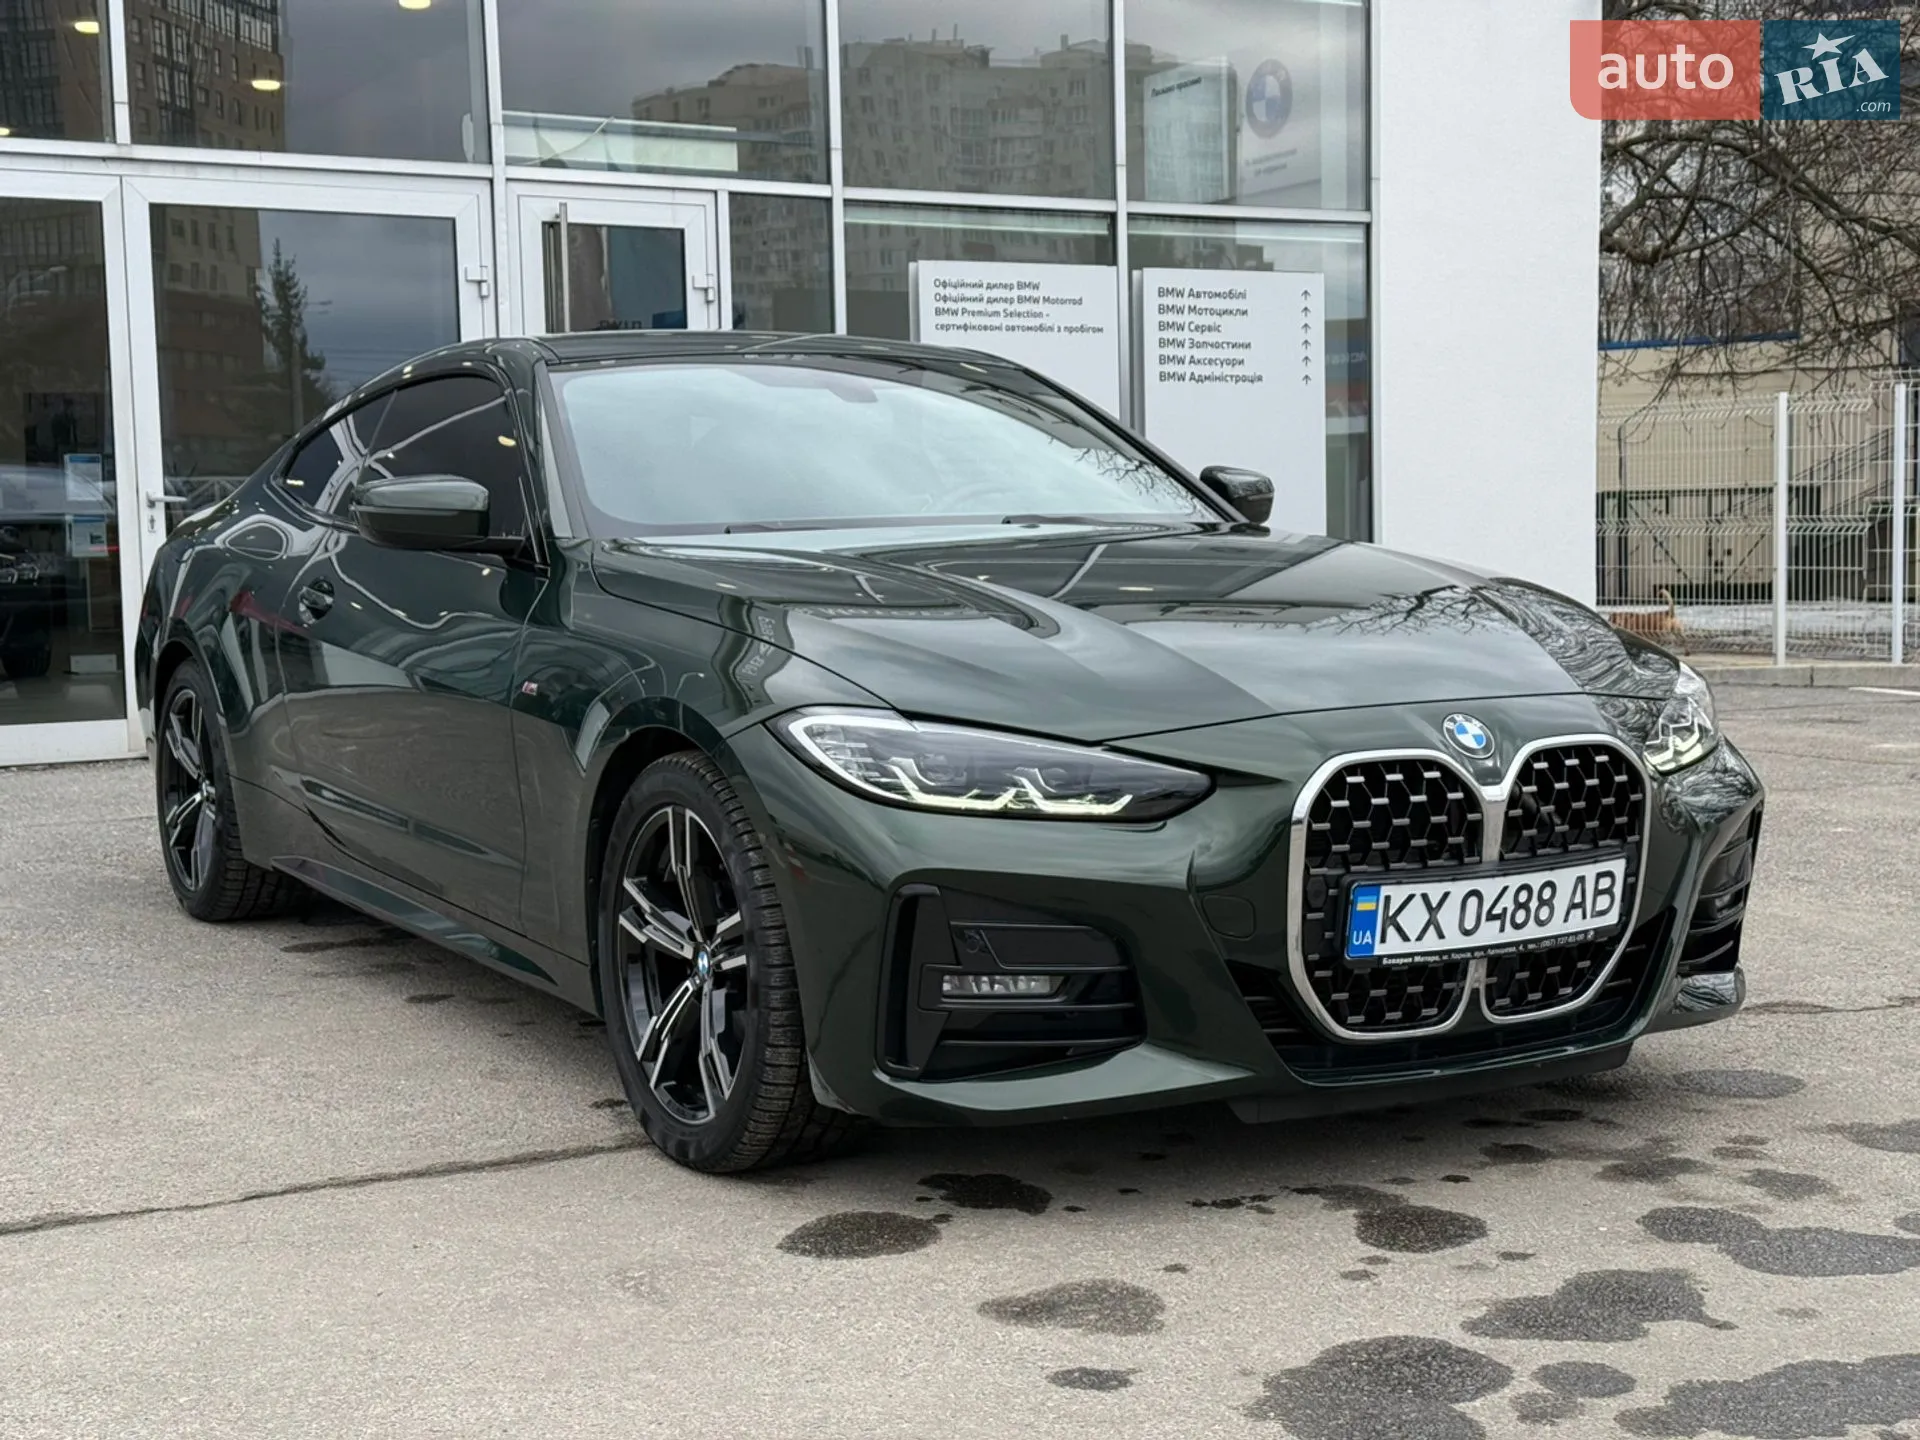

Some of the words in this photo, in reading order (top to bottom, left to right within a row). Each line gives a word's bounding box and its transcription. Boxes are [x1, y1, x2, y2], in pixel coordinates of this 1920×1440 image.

[933, 278, 984, 290] Офіційний
[986, 281, 1015, 292] дилер
[1017, 281, 1041, 291] BMW
[934, 292, 984, 304] Офіційний
[986, 295, 1015, 306] дилер
[1017, 295, 1041, 305] BMW
[1042, 296, 1083, 306] Motorrad
[1158, 286, 1185, 299] BMW
[1187, 287, 1247, 300] Автомобілі
[934, 307, 959, 317] BMW
[961, 308, 1001, 318] Premium
[1002, 309, 1044, 319] Selection
[1158, 303, 1185, 315] BMW
[1187, 304, 1248, 317] Мотоцикли
[935, 322, 1002, 333] сертифіковані
[1005, 322, 1055, 333] автомобілі
[1063, 324, 1104, 334] пробігом
[1158, 320, 1186, 332] BMW
[1187, 320, 1222, 334] Сервіс
[1158, 337, 1186, 349] BMW
[1188, 337, 1252, 350] Запчастини
[1158, 354, 1186, 366] BMW
[1188, 354, 1245, 368] Аксесуари
[1159, 370, 1186, 383] BMW
[1189, 370, 1263, 384] Адміністрація
[1379, 890, 1451, 944] KX
[1457, 879, 1558, 937] 0488
[1563, 869, 1617, 924] AB
[1353, 930, 1372, 946] UA
